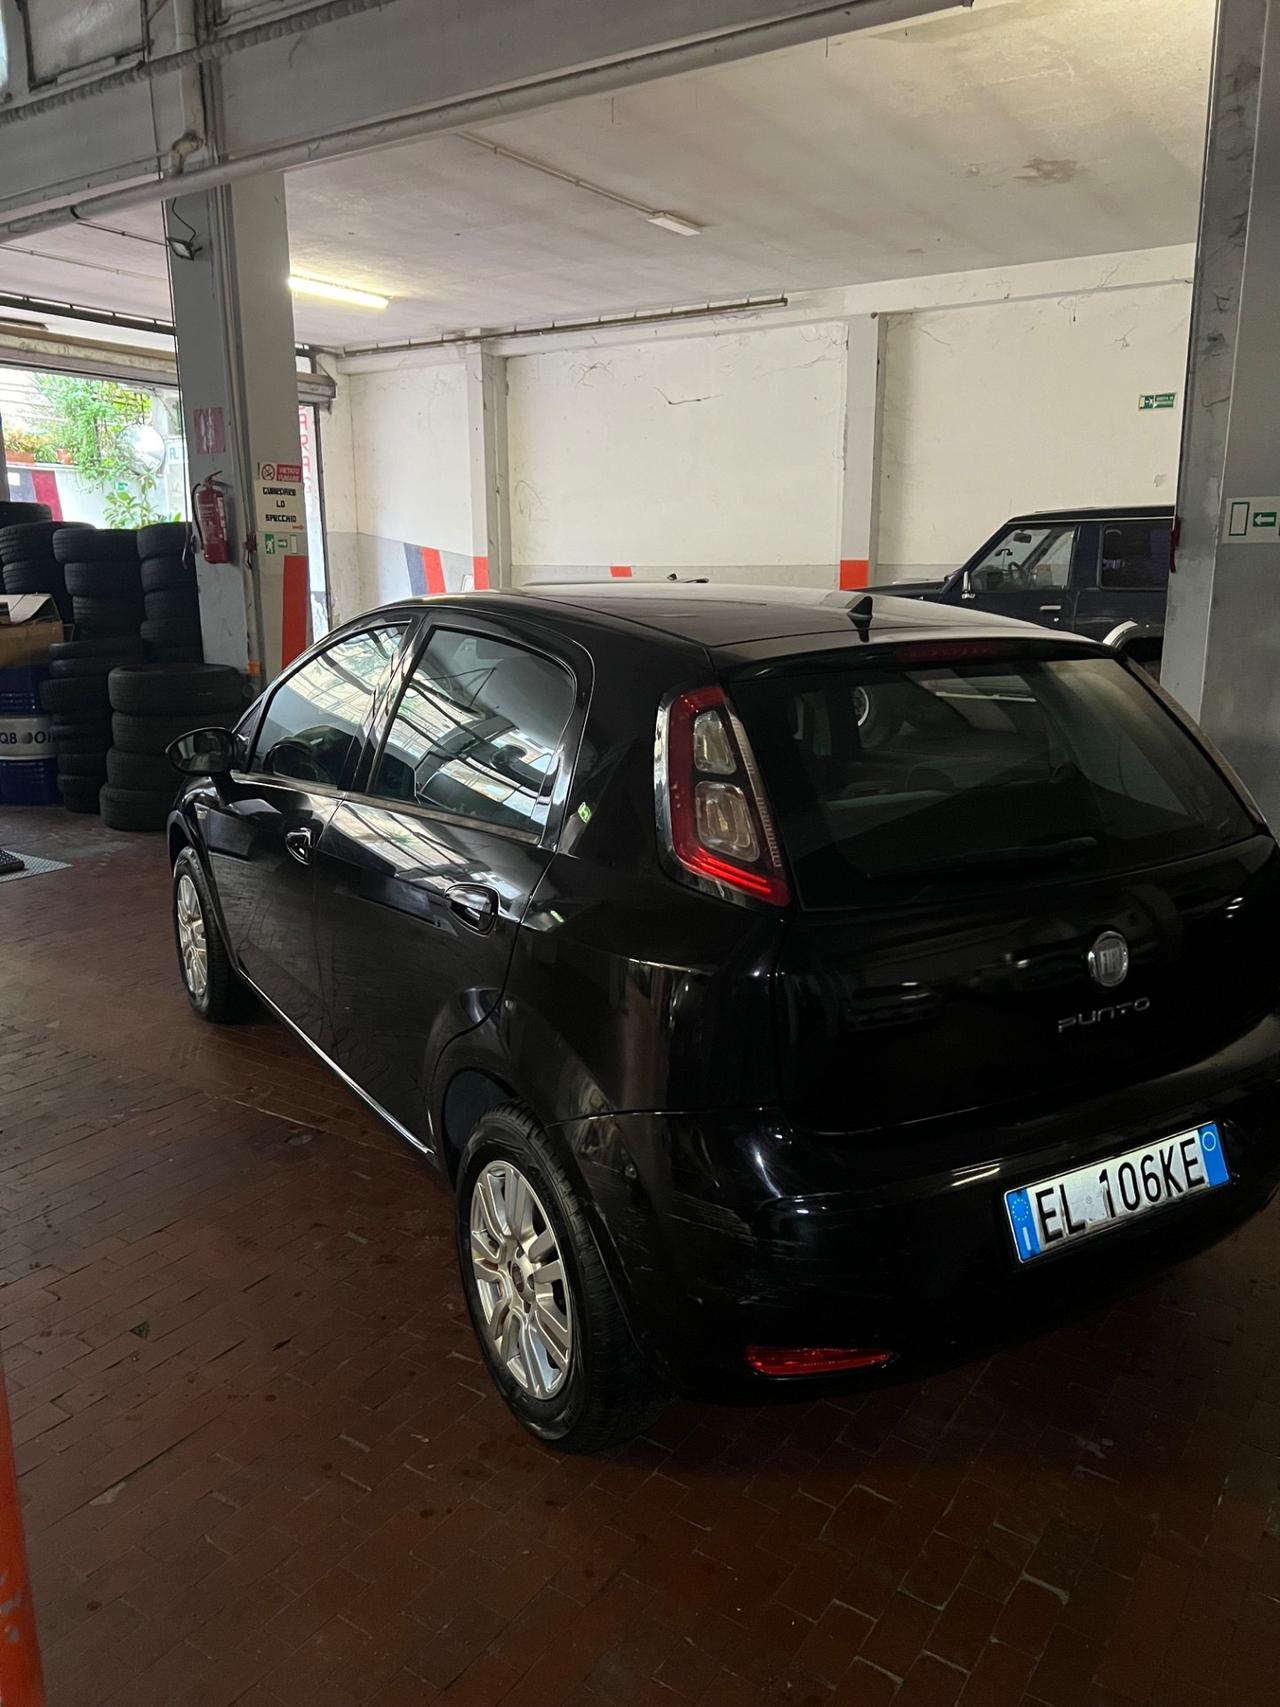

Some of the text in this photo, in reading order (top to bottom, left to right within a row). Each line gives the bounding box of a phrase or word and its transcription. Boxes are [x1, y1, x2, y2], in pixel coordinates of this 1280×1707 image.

[276, 500, 286, 508] LO
[1058, 997, 1150, 1032] PUNTO
[1035, 1137, 1205, 1243] EL 106KE
